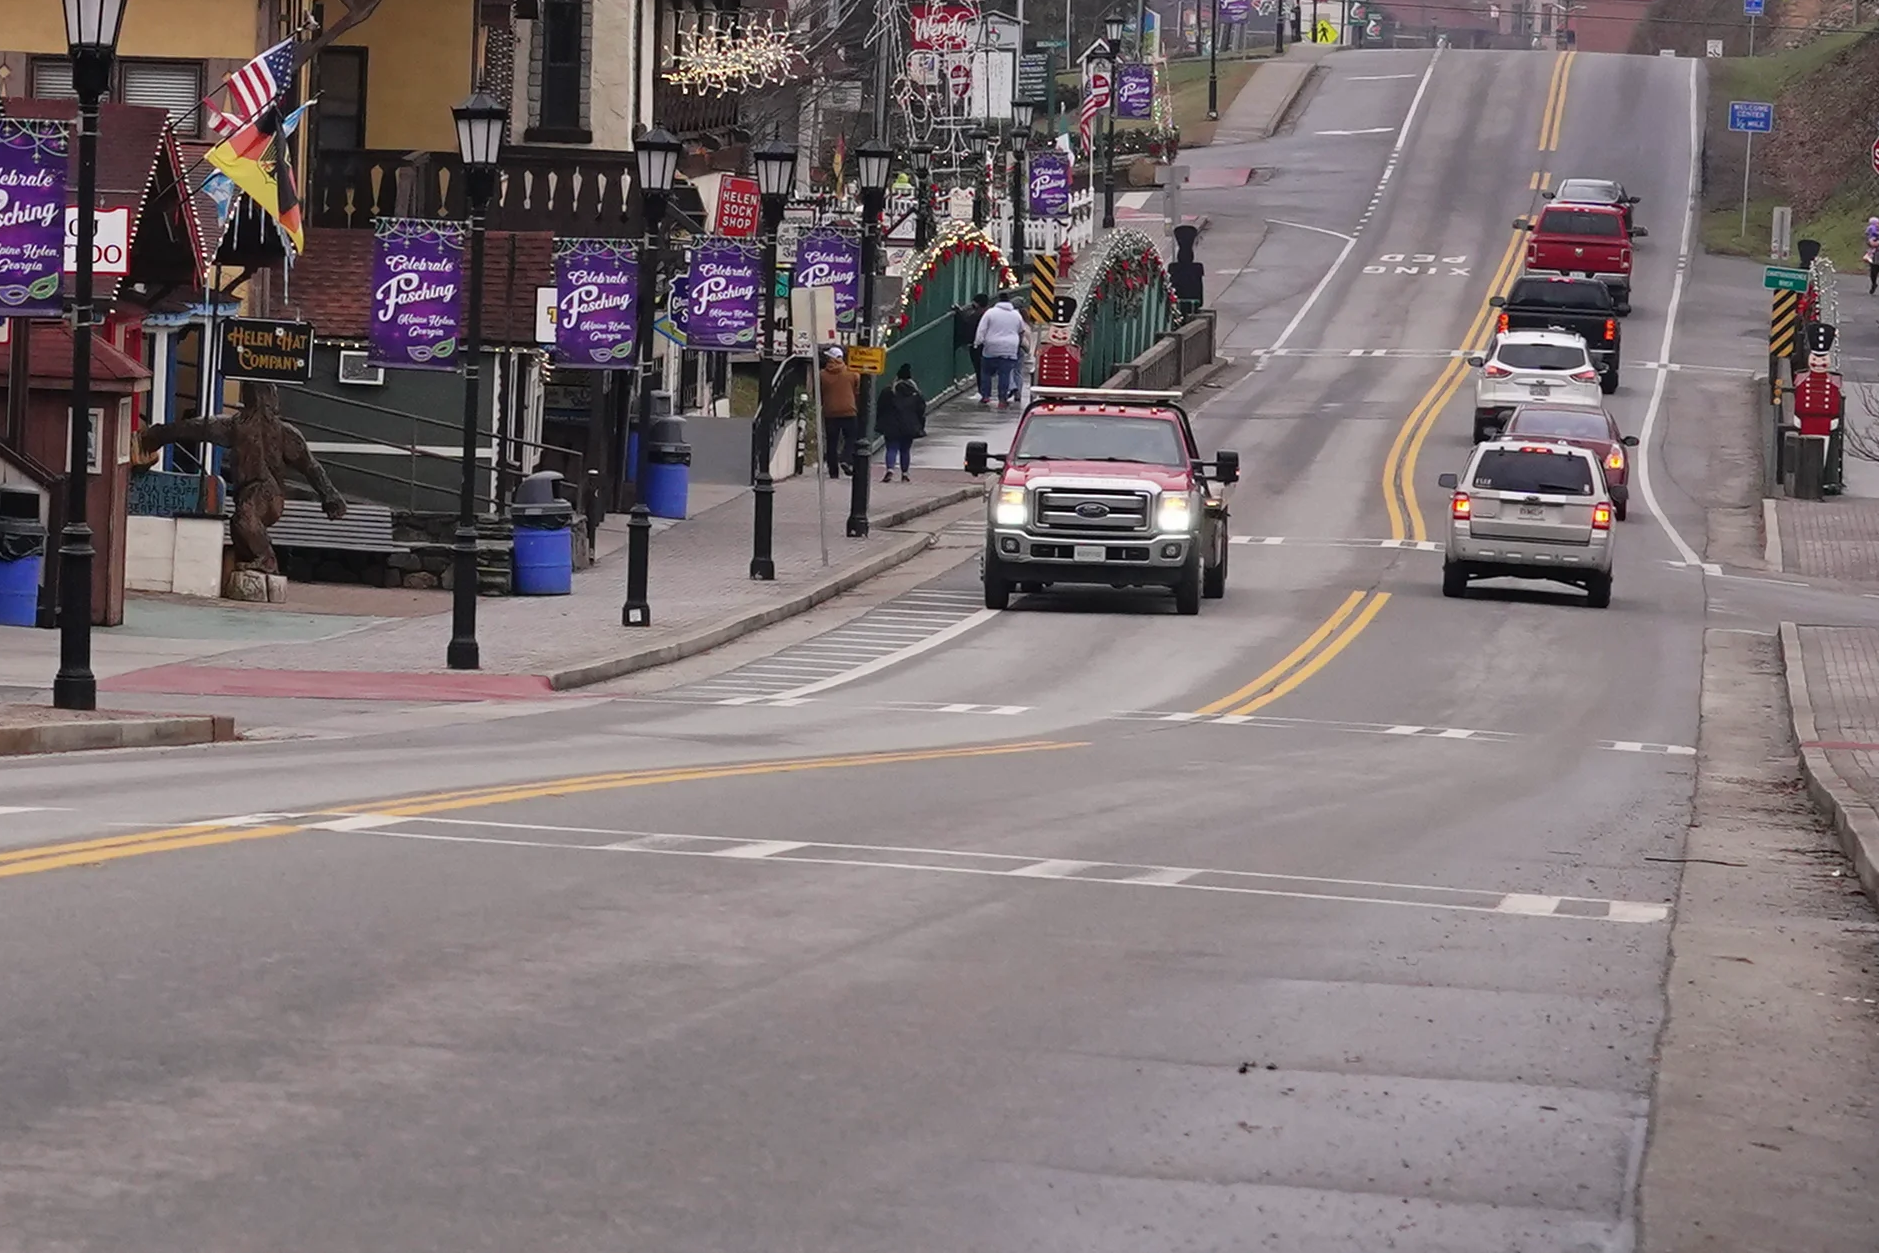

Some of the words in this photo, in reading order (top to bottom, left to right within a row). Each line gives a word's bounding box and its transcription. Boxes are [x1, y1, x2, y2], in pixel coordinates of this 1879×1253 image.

[913, 13, 968, 42] Wendy
[1734, 104, 1769, 113] WELCOME
[722, 190, 757, 204] HELEN
[723, 204, 753, 217] SOCK
[722, 215, 752, 229] SHOP
[385, 254, 454, 273] Celebrate
[699, 263, 753, 278] Celebrate
[568, 270, 629, 285] Celebrate
[375, 273, 457, 321] Fasching
[691, 277, 756, 315] Fasching
[560, 285, 632, 329] Fasching
[227, 327, 273, 346] HELEN
[275, 328, 308, 350] HAT
[238, 348, 300, 371] COMPANY
